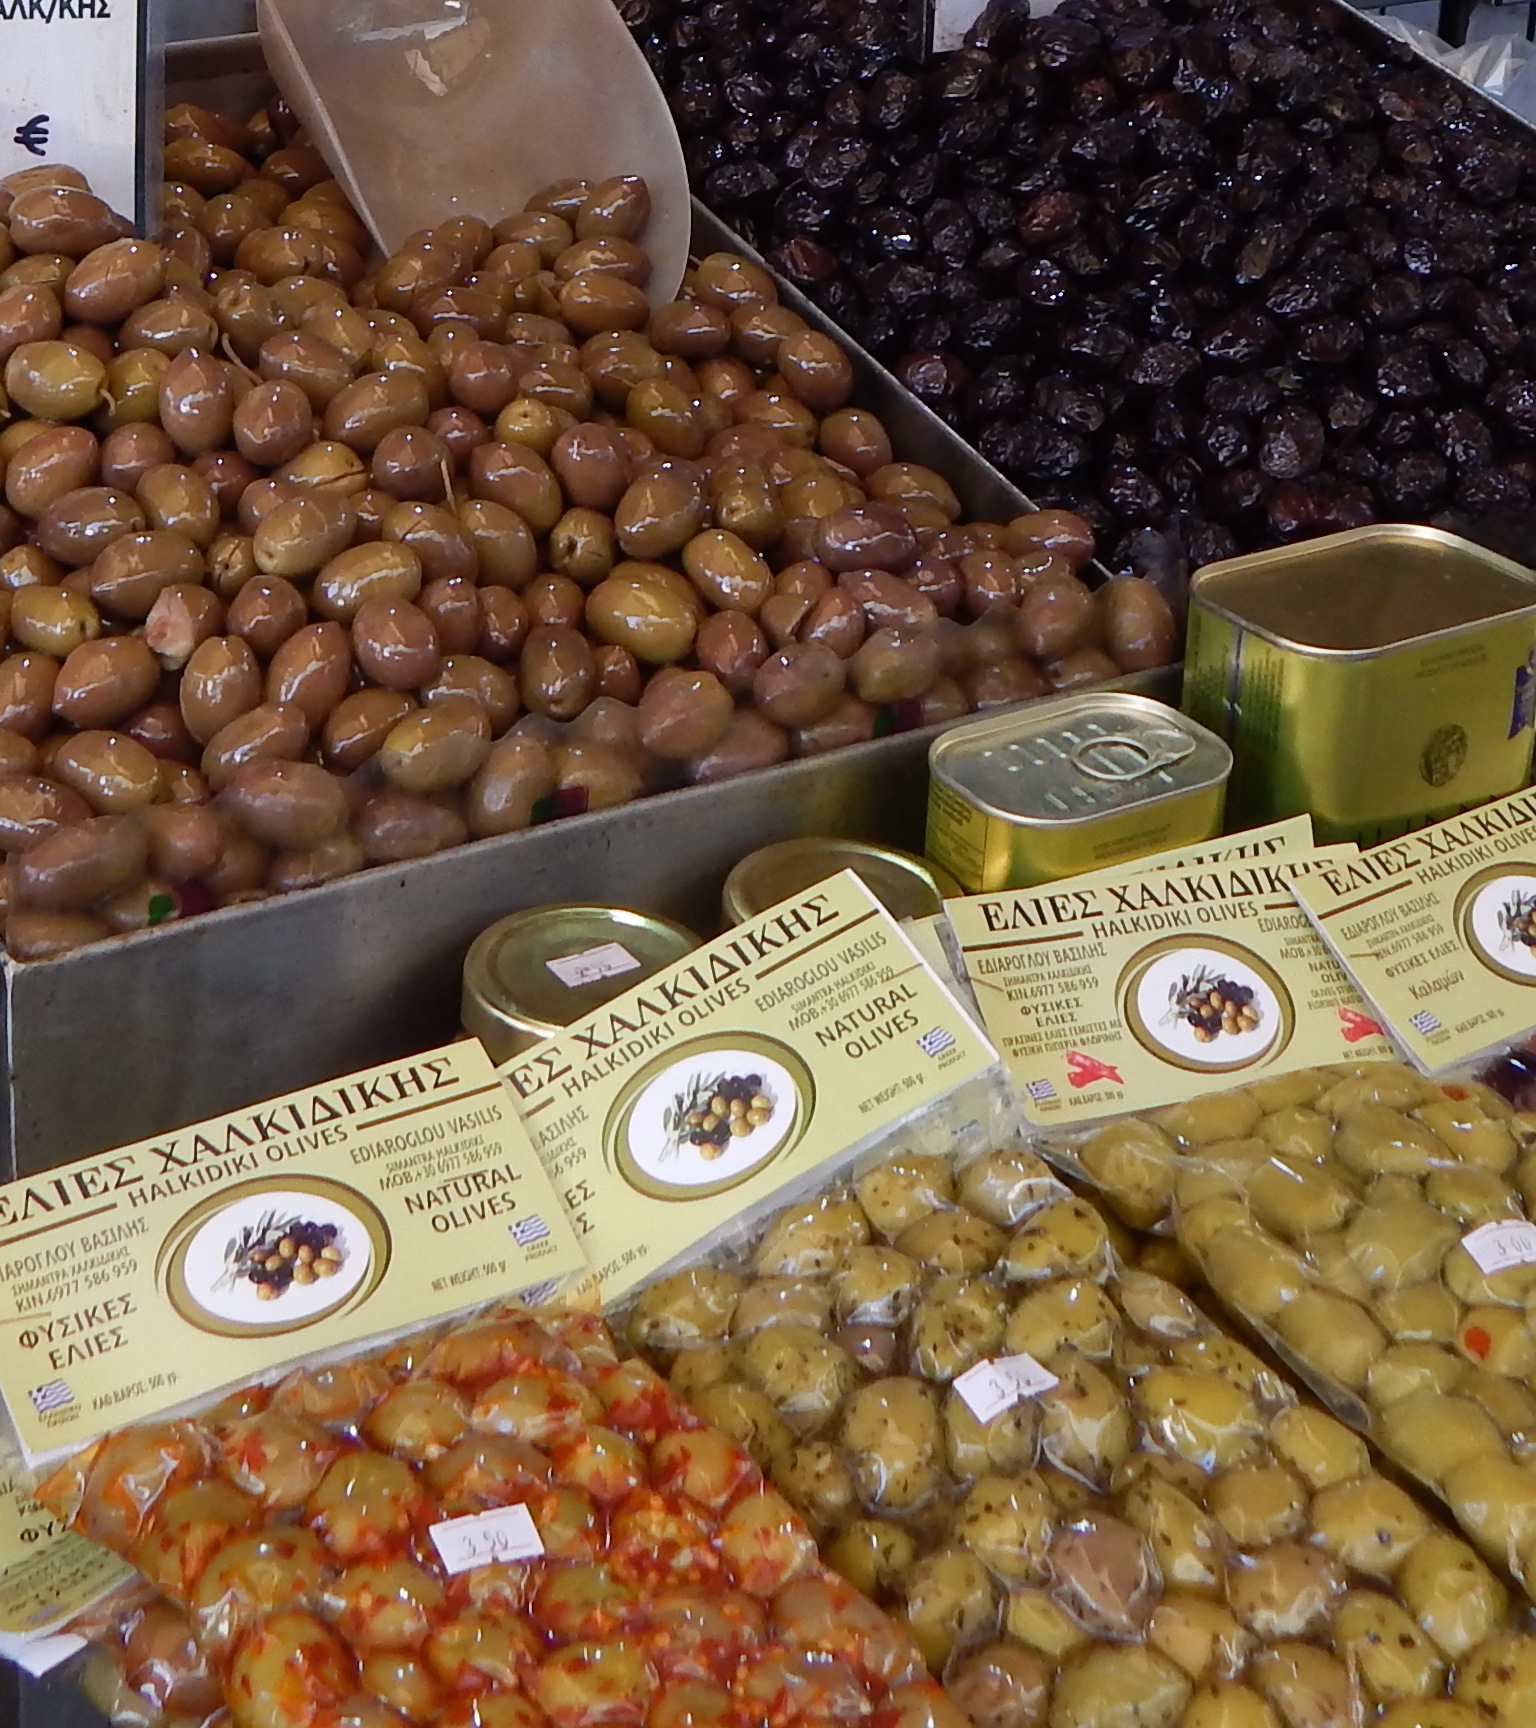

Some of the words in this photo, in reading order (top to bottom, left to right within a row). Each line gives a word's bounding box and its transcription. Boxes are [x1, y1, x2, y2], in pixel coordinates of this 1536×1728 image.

[13, 114, 50, 156] €
[1323, 844, 1420, 897] ΕΛΙΕΣ
[1417, 844, 1494, 884] HALKIDIKI
[978, 889, 1104, 933] ΕΛΙΕΣ
[1092, 910, 1193, 939] HALKIDIKI
[1196, 901, 1259, 922] OLIVES
[571, 894, 839, 1059] ΧΑΛΚΙΔΙΚΗΣ
[755, 958, 839, 1013] EDIAROGLOU
[837, 931, 887, 965] VASILIS
[977, 951, 1051, 975] ΕΔΙΑΡΟΓΛΟΥ
[1054, 942, 1107, 964] ΒΑΣΙΛΗΣ
[815, 983, 918, 1047] NATURAL
[1020, 997, 1083, 1017] ΦΥΣΙΚΕΣ
[1035, 1012, 1078, 1028] ΕΛΙΕΣ
[562, 1022, 676, 1099] HALKIDIKI
[678, 976, 751, 1029] OLIVES
[845, 1009, 919, 1059] OLIVES
[149, 1056, 459, 1174] ΧΑΛΚΙΔΙΚΗΣ
[349, 1123, 446, 1165] EDIAROGLOU
[447, 1104, 503, 1135] VASILIS
[128, 1153, 262, 1208] HALKIDIKI
[267, 1122, 350, 1163] OLIVES
[403, 1163, 522, 1214] NATURAL
[81, 1216, 150, 1255] ΒΑΣΙΛΗΣ
[431, 1191, 517, 1233] OLIVES
[85, 1268, 111, 1289] 586
[113, 1259, 138, 1280] 959
[18, 1293, 138, 1349] ΦΥΣΙΚΕΣ
[48, 1325, 130, 1371] ΕΛΙΕΣ
